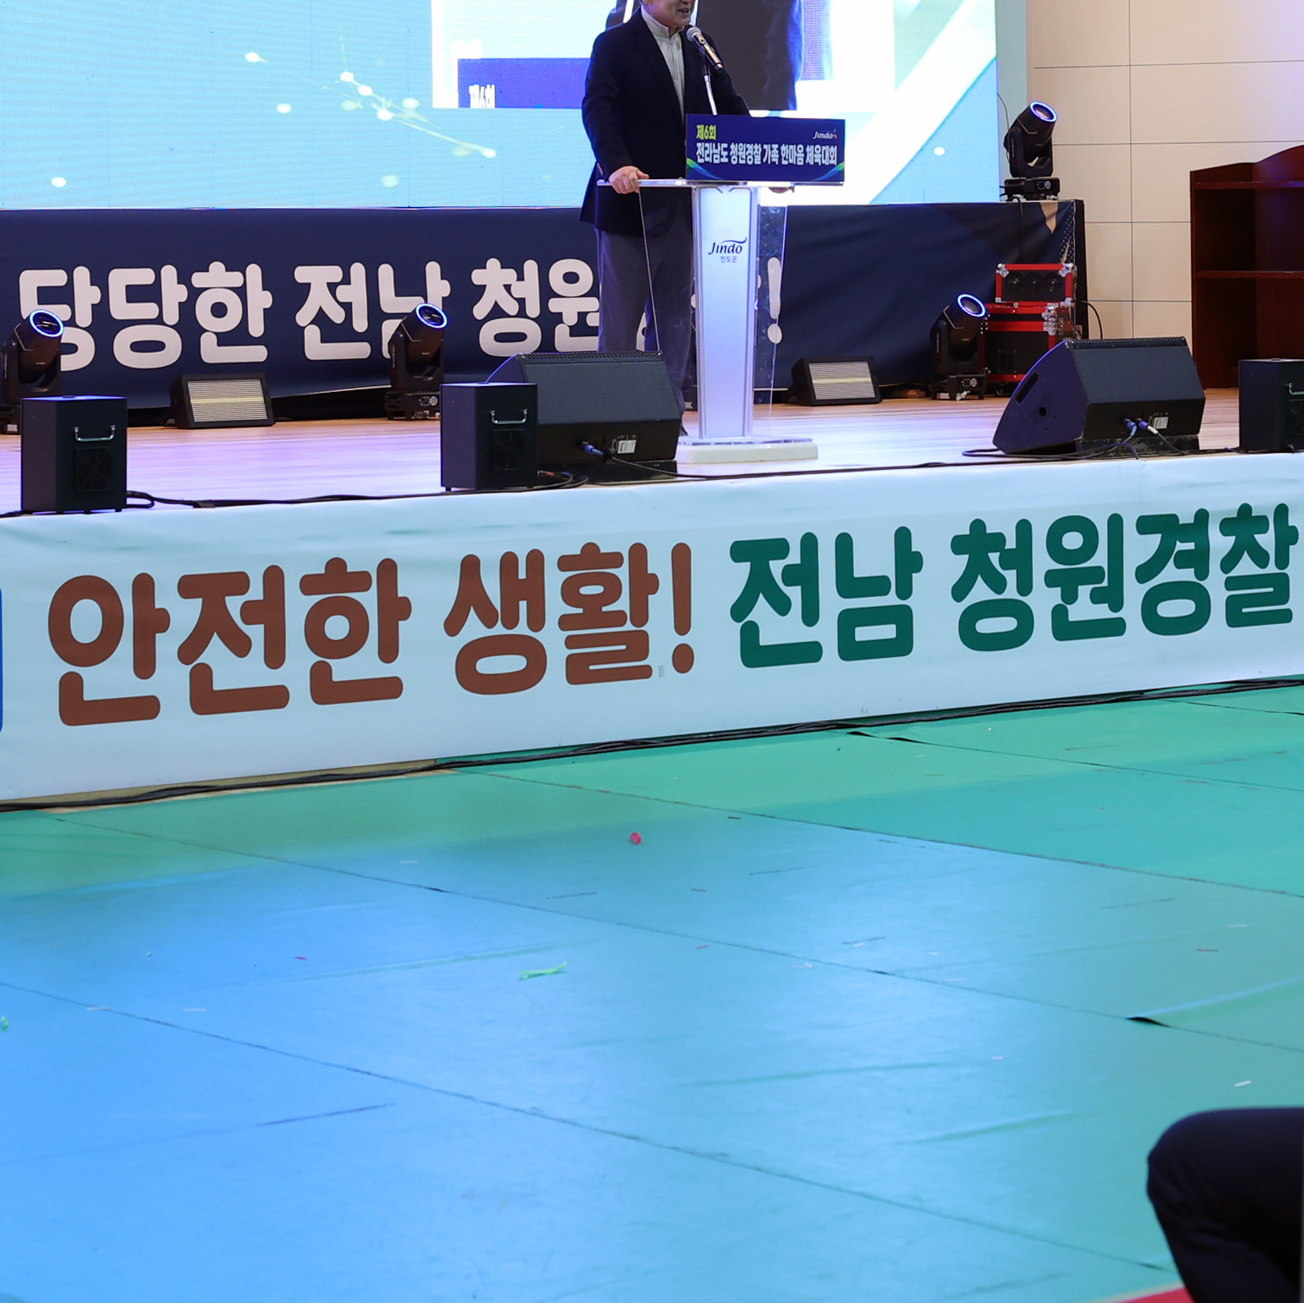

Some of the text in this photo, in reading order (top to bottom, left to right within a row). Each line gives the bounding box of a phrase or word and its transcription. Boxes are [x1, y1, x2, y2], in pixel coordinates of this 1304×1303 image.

[696, 142, 729, 164] 전라남도
[763, 143, 779, 165] 가족
[780, 144, 804, 166] 한마음
[805, 144, 838, 166] 체육대회
[708, 240, 744, 256] Jindo
[19, 261, 273, 371] 당당한
[48, 556, 411, 728] 안전한
[443, 541, 694, 695] 생활!
[729, 525, 923, 669] 전남
